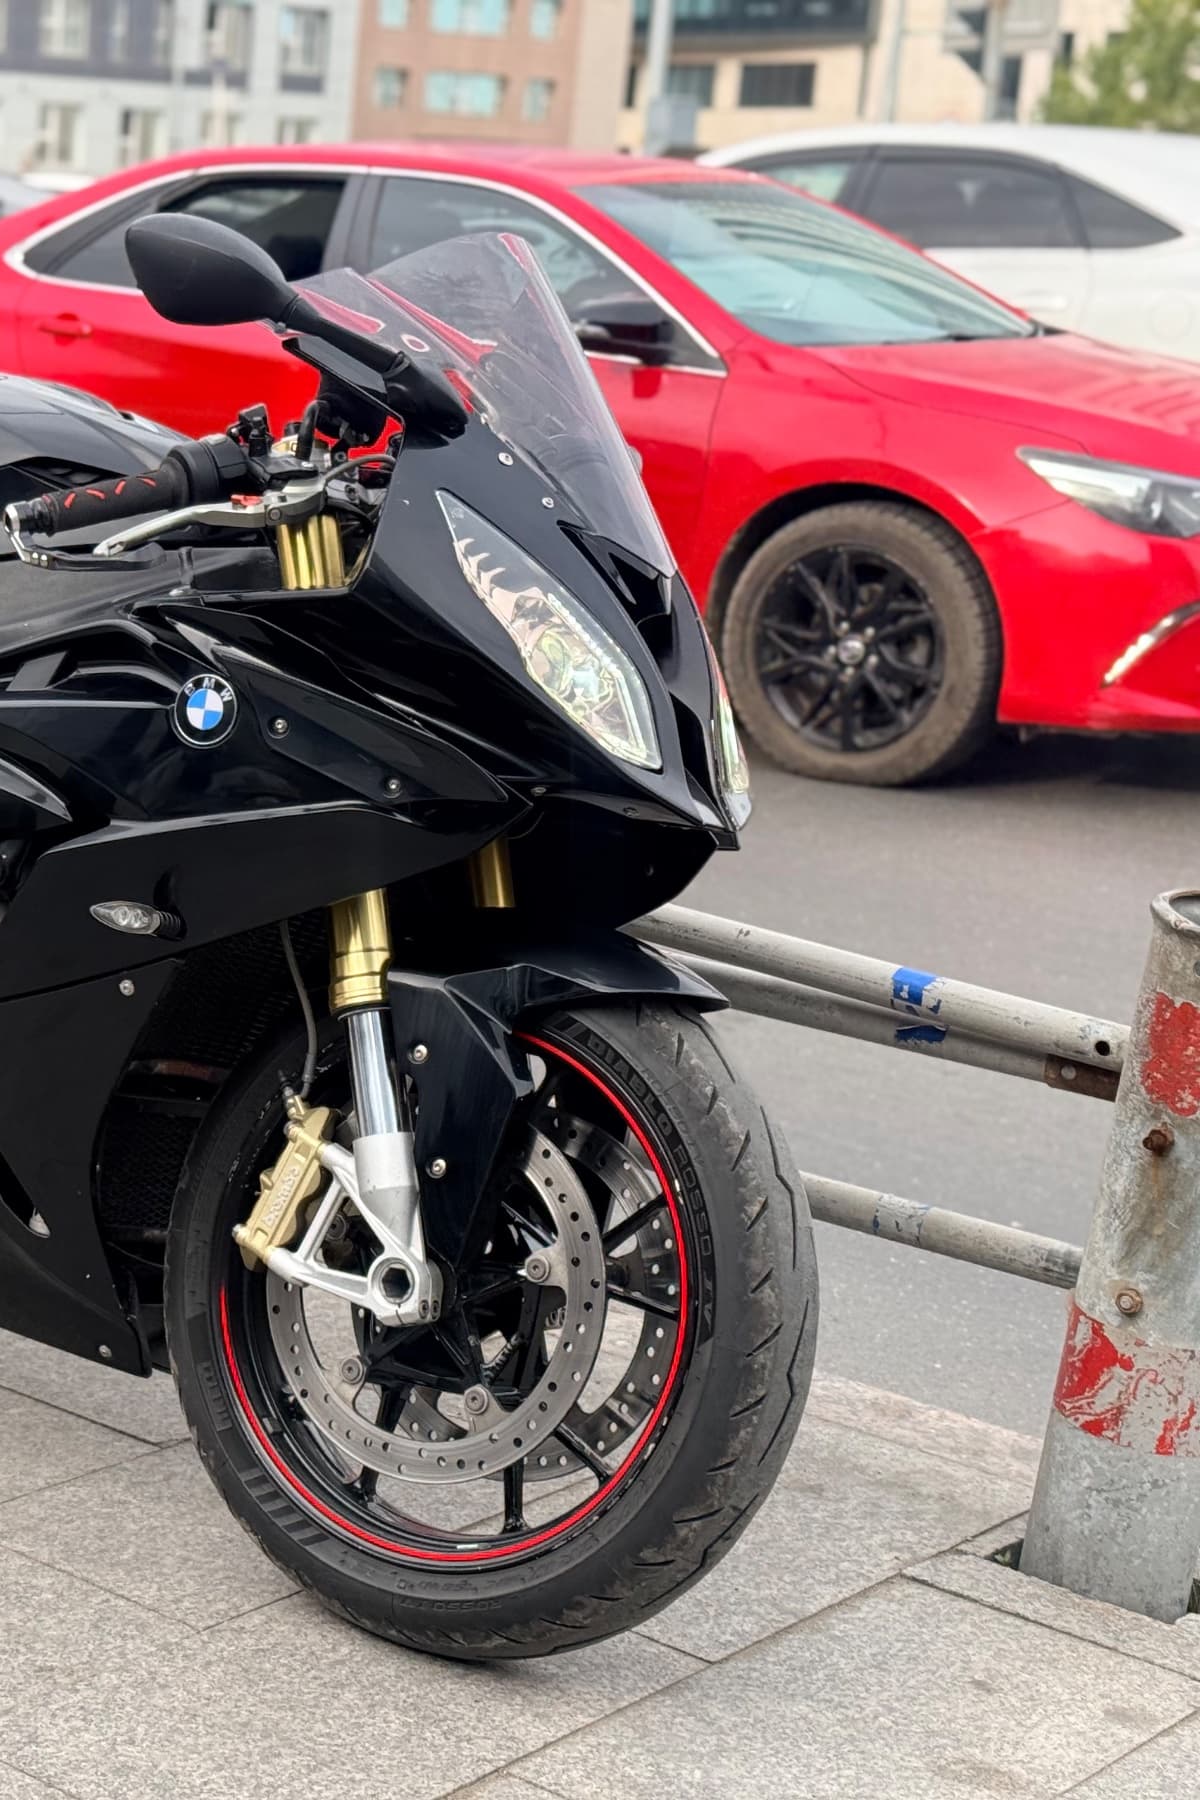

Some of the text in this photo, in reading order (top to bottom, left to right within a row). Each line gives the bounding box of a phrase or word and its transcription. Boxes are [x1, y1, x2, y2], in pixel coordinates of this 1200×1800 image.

[183, 676, 233, 702] BMW
[586, 1031, 674, 1137] DIABLO
[672, 1145, 712, 1256] ROSSO
